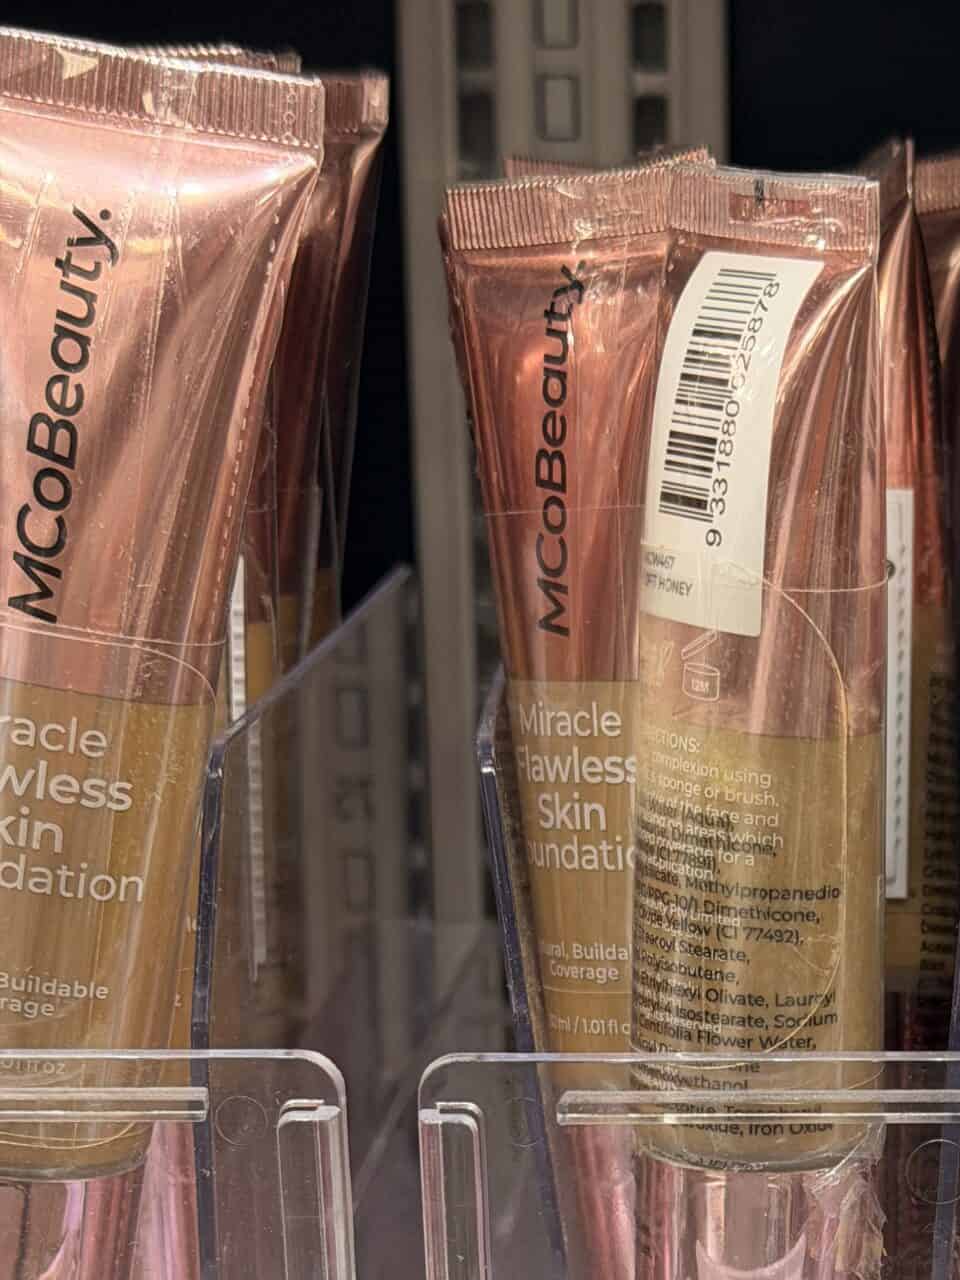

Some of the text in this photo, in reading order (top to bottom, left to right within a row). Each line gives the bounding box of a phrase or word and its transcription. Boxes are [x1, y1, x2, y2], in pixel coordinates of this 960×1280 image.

[710, 399, 740, 515] 331880
[705, 528, 722, 546] 9
[520, 701, 622, 737] Miracle
[724, 767, 772, 790] using
[725, 786, 780, 808] brush.
[538, 792, 607, 831] Skin
[743, 812, 779, 827] and
[730, 829, 784, 849] which
[717, 846, 755, 867] for a
[703, 900, 820, 924] Dimethicone,
[742, 928, 804, 945] 77492),
[679, 940, 750, 965] Stearate,
[551, 960, 619, 984] Coverage
[705, 988, 769, 1009] Olivate,
[697, 1029, 754, 1049] Flower
[758, 1033, 817, 1050] Water,
